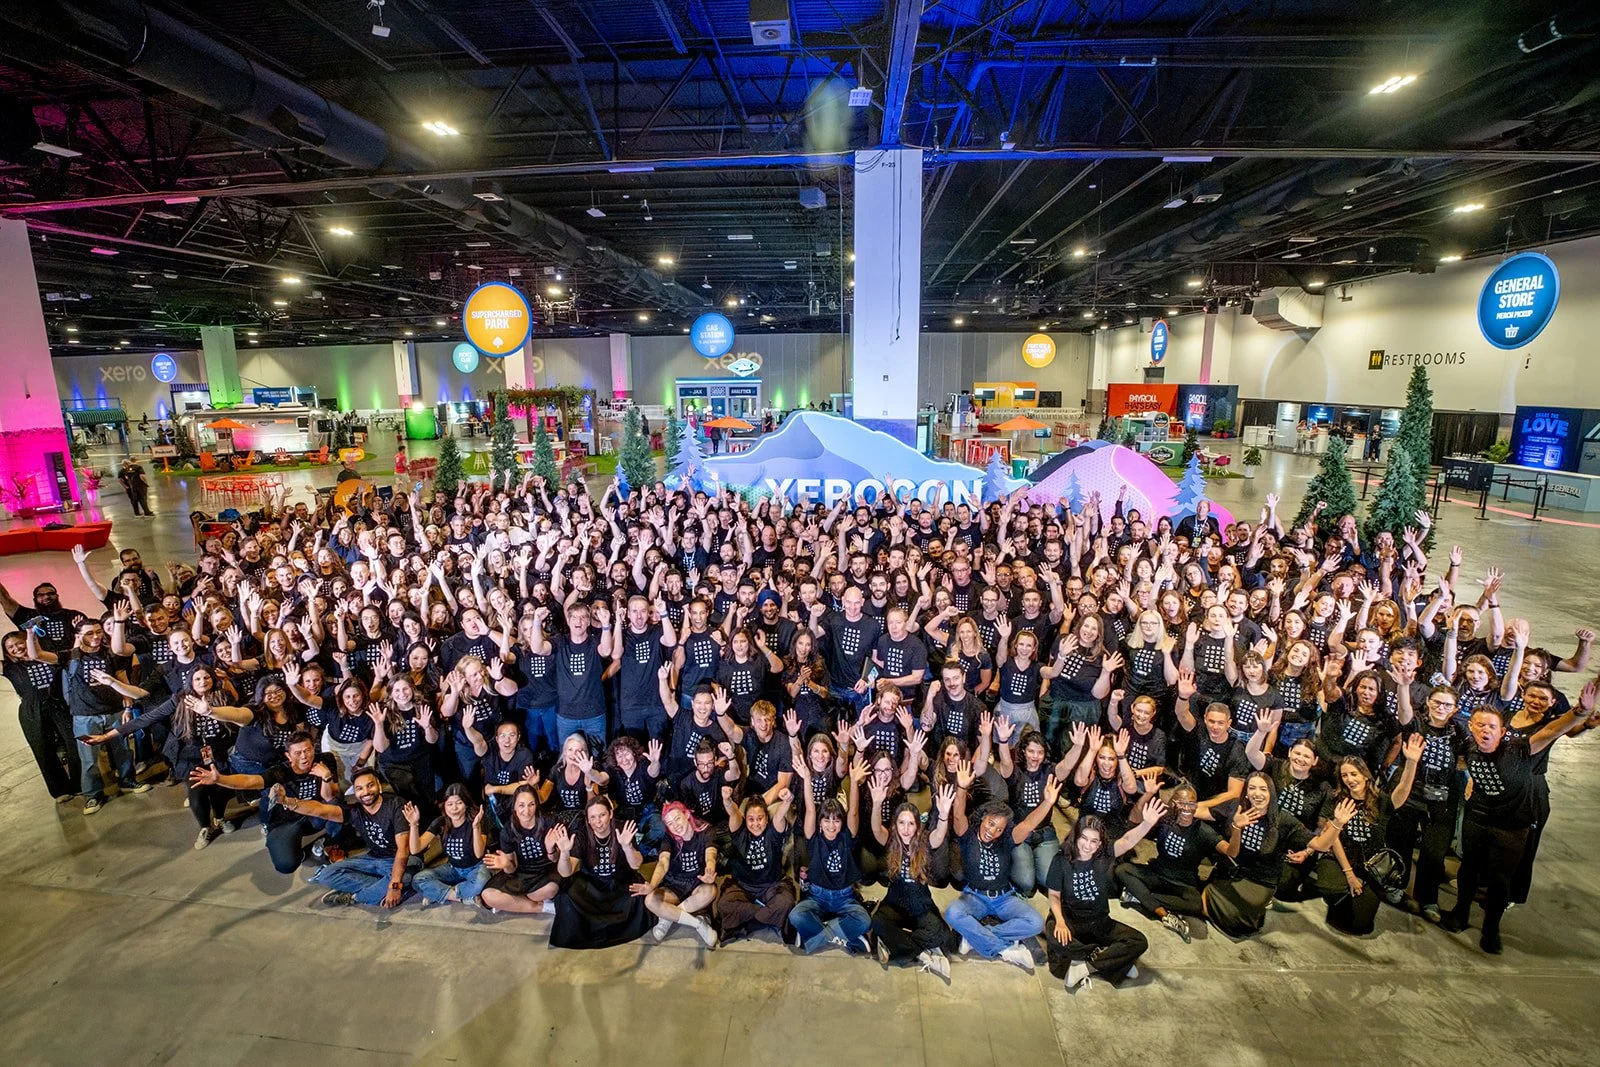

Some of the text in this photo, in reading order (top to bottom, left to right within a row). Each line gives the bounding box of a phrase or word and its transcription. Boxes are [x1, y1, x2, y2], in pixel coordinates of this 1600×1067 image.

[1494, 274, 1544, 294] GENERAL
[1498, 291, 1536, 308] STORE
[472, 310, 522, 319] SUPERCHARGED
[1496, 310, 1533, 320] MERCH PICKUP
[485, 318, 510, 330] PARK
[1384, 352, 1466, 366] RESTROOMS
[99, 366, 146, 382] xero
[1129, 394, 1158, 402] PAYROLL
[1124, 402, 1162, 410] THAT'S EASY
[1522, 418, 1569, 437] LOVE
[764, 478, 982, 512] XEROCON
